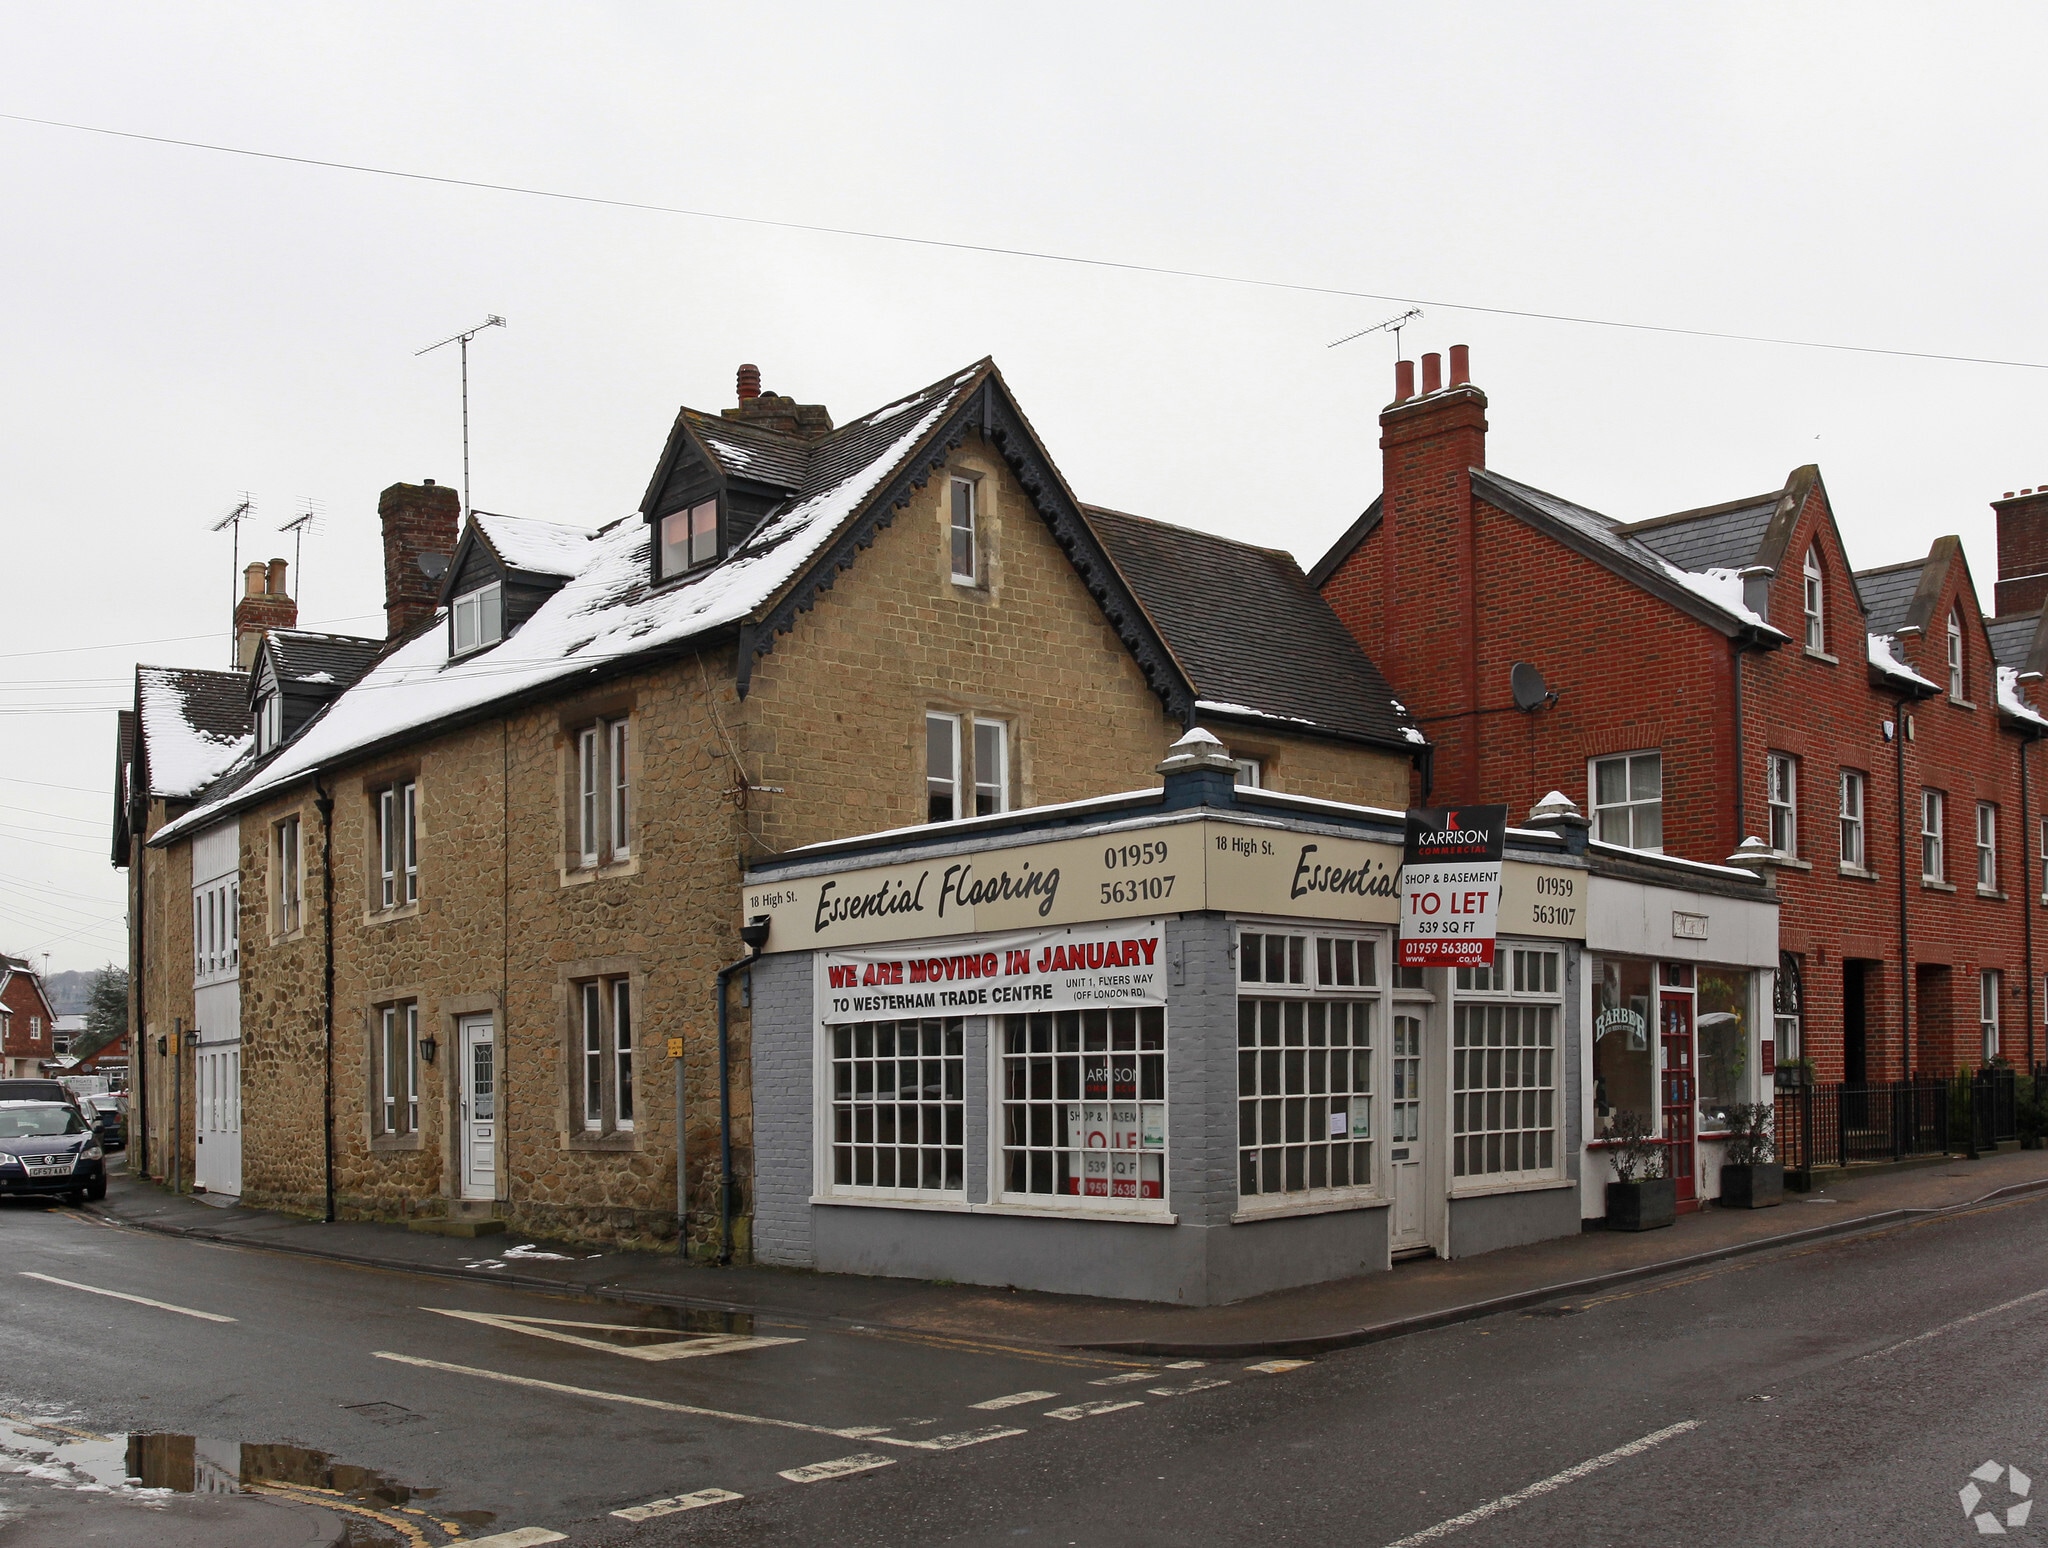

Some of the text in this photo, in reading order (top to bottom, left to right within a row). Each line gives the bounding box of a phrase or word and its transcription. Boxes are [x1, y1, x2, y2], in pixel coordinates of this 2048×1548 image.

[1215, 836, 1275, 857] 18 High St.
[1418, 829, 1489, 845] KARRISON
[1105, 841, 1168, 869] 01959
[1418, 845, 1487, 855] COMMERCIAL
[1405, 872, 1498, 884] SHOP & BASEMENT
[1536, 875, 1573, 897] 01959
[814, 861, 1060, 933] Essential Flooring
[1100, 875, 1176, 904] 563107
[750, 891, 798, 908] 18 High St.
[1410, 892, 1441, 915] TO
[1451, 892, 1489, 914] LET
[1532, 904, 1576, 926] 563107
[1418, 921, 1475, 933] 539 SQ FT
[1405, 942, 1483, 954] 01959 563800
[828, 937, 1159, 989] WE ARE MOVING IN JANUARY
[1066, 977, 1085, 988] UNIT
[1099, 975, 1130, 986] FLYERS
[1133, 973, 1153, 984] WAY
[833, 984, 1053, 1012] TO WESTERHAM TRADE CENTRE
[1073, 988, 1146, 1001] (OFF LONDON RD)
[1595, 1007, 1646, 1043] BARBER
[1097, 1112, 1103, 1121] &
[1088, 1161, 1107, 1172] 539
